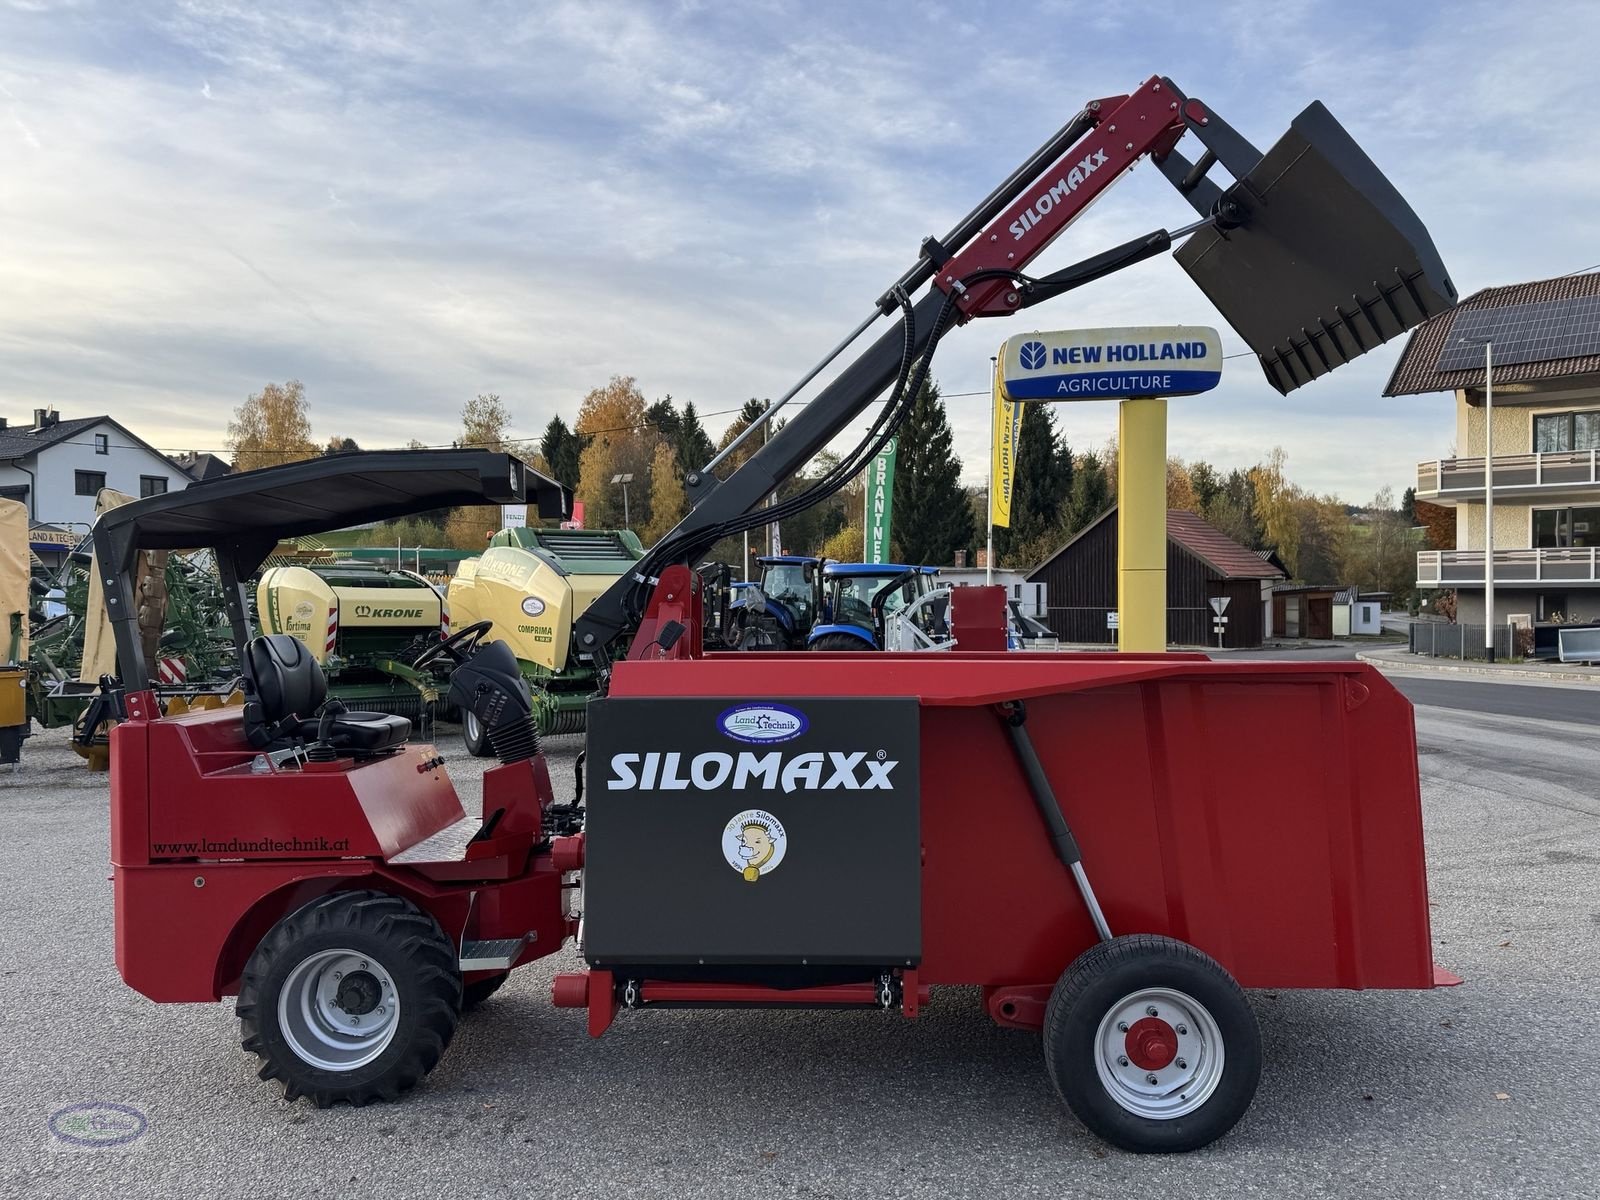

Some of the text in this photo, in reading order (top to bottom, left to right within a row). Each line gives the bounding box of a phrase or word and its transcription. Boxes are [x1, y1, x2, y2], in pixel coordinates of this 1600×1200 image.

[1052, 341, 1207, 365] NEW HOLLAND
[1057, 375, 1171, 393] AGRICULTURE
[873, 457, 887, 564] BRANTNER
[491, 561, 526, 577] KRONE
[372, 608, 424, 618] KRONE
[286, 616, 311, 631] Fortima
[517, 624, 553, 635] COMPRIMA
[734, 715, 796, 730] Land Technik
[734, 812, 754, 825] Jahre
[755, 811, 785, 838] Silomaxx
[153, 836, 350, 854] www.landundtechnik.at
